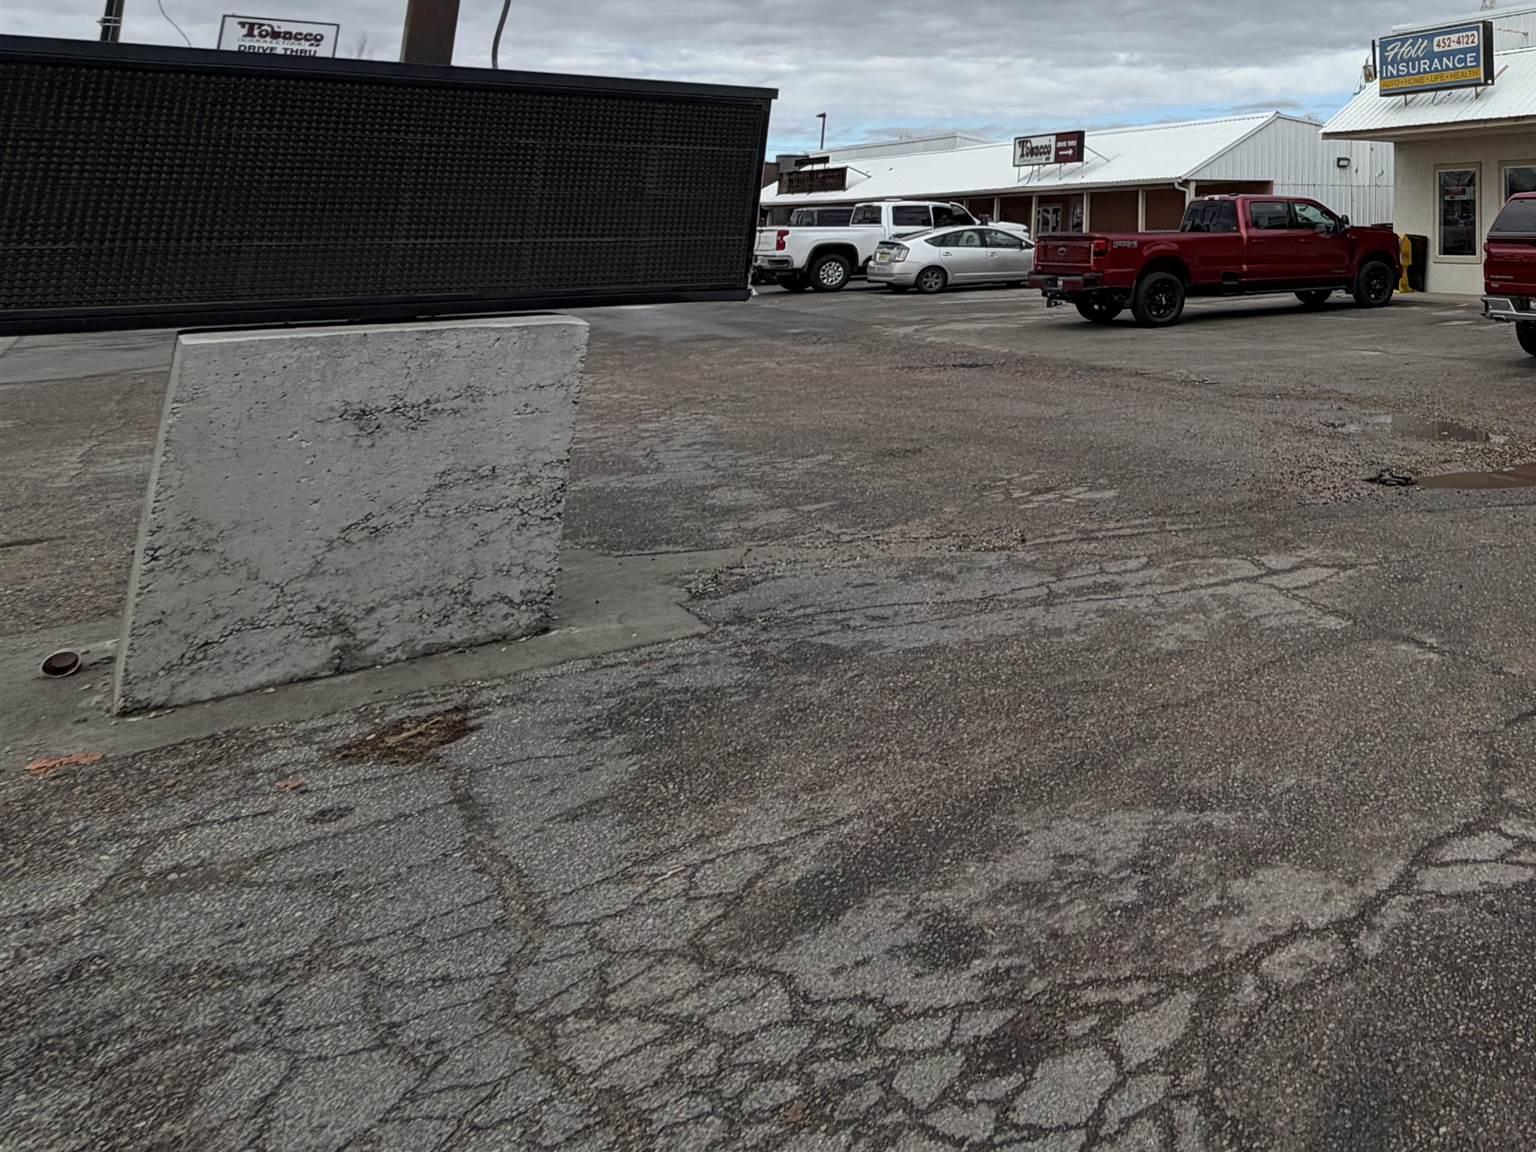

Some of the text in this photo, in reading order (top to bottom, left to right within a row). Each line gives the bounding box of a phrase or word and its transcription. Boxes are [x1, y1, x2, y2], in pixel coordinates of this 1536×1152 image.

[237, 21, 324, 43] Tobacco
[1435, 33, 1476, 49] 452-4122
[237, 43, 318, 57] DRIVE THRU
[1384, 38, 1428, 62] Holt
[1382, 52, 1477, 77] INSURANCE
